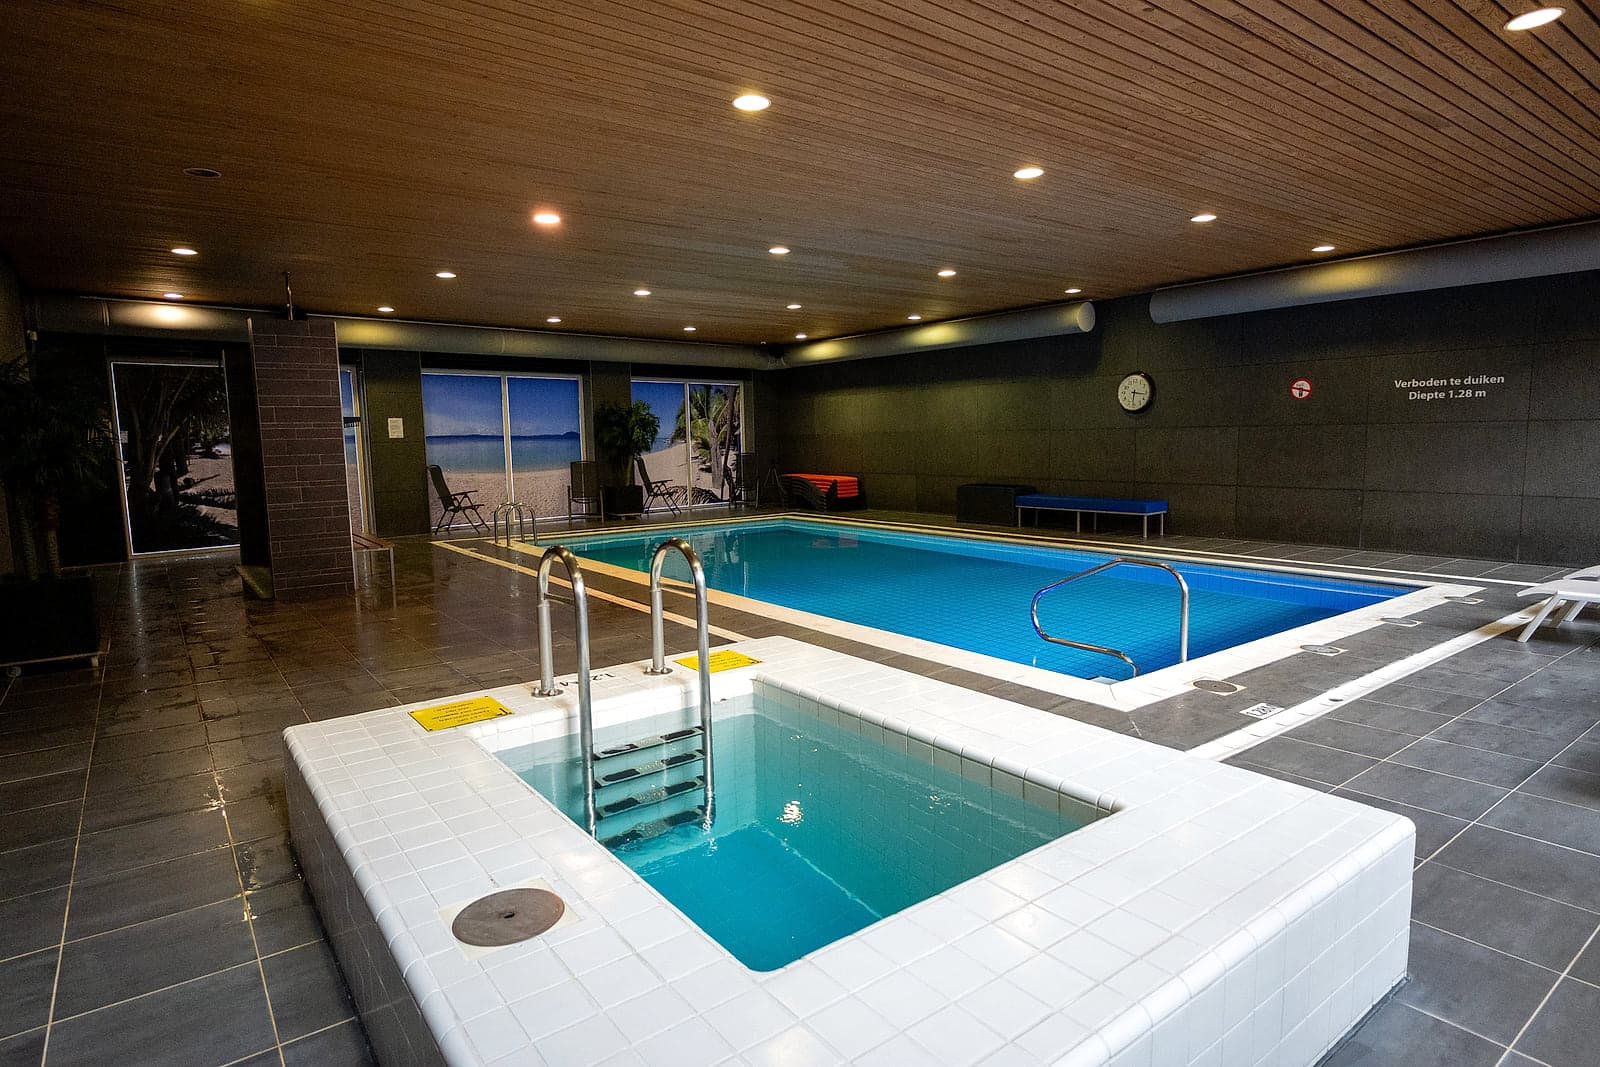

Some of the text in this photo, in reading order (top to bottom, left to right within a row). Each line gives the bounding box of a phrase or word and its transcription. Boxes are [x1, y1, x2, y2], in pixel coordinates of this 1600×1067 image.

[1394, 375, 1505, 388] Verboden te duiken
[1408, 389, 1487, 401] Diepte 1.28 m
